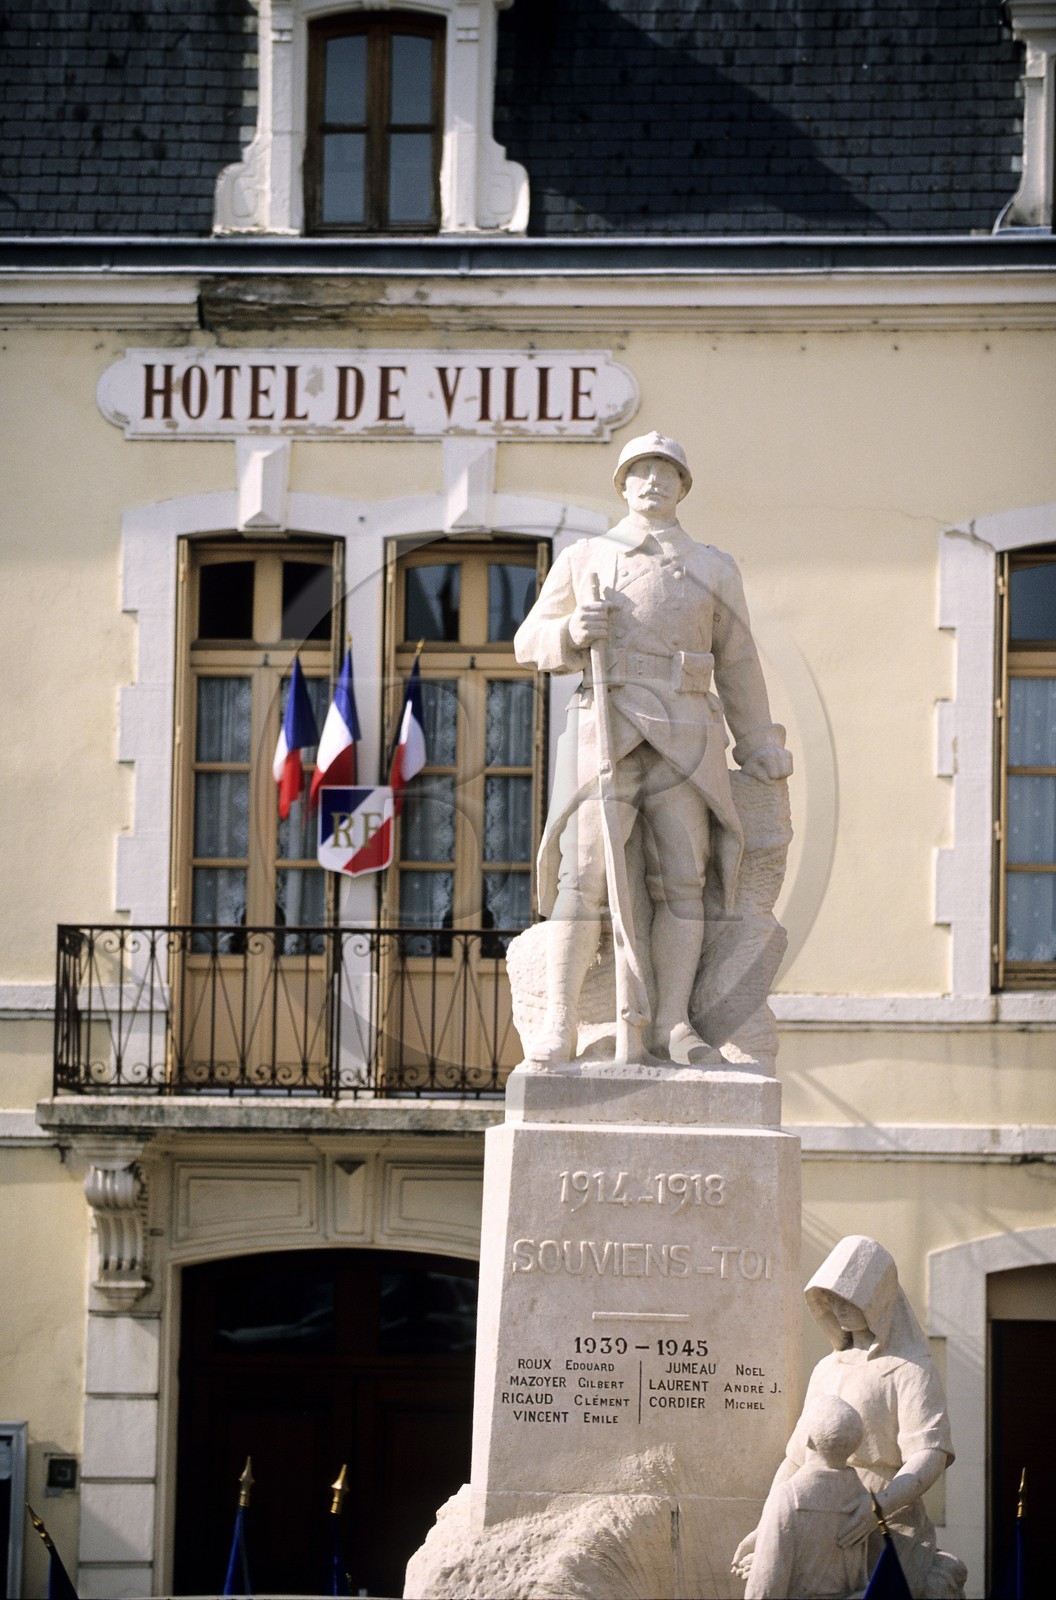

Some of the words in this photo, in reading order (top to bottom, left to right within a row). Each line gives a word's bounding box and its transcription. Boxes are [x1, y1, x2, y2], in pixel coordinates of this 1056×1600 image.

[142, 364, 309, 421] HOTEL
[333, 365, 408, 422] DE
[433, 366, 598, 422] VILLE
[329, 811, 384, 850] RF
[517, 1358, 552, 1370] ROUX
[665, 1362, 717, 1375] JUMEAU
[509, 1375, 567, 1388] MAZOYER
[649, 1379, 709, 1392] LAURENT
[769, 1382, 782, 1394] J.
[501, 1392, 553, 1405] RIGAUD
[649, 1396, 706, 1409] CORDIER
[513, 1410, 570, 1423] VINCENT
